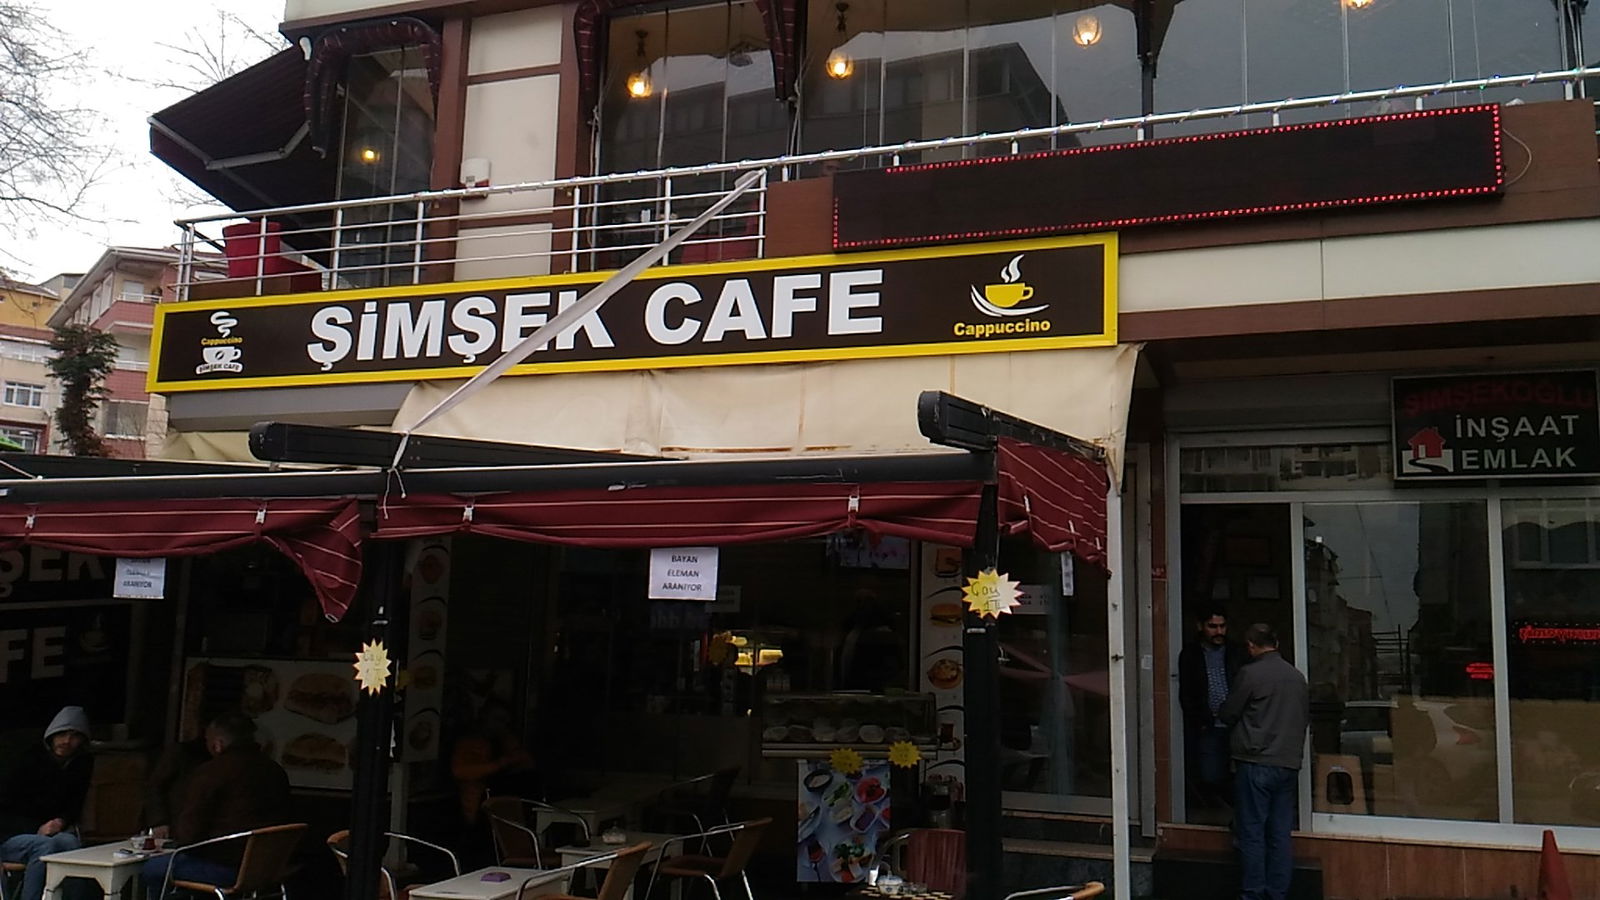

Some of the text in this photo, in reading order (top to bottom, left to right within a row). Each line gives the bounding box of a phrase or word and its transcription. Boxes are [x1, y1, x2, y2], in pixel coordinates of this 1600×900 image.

[644, 269, 883, 345] CAFE
[953, 317, 1051, 338] Cappuccino
[1455, 414, 1579, 442] İNŞAAT
[1461, 447, 1577, 470] EMLAK
[671, 555, 698, 563] BAYAN
[667, 569, 699, 577] ELEMAN
